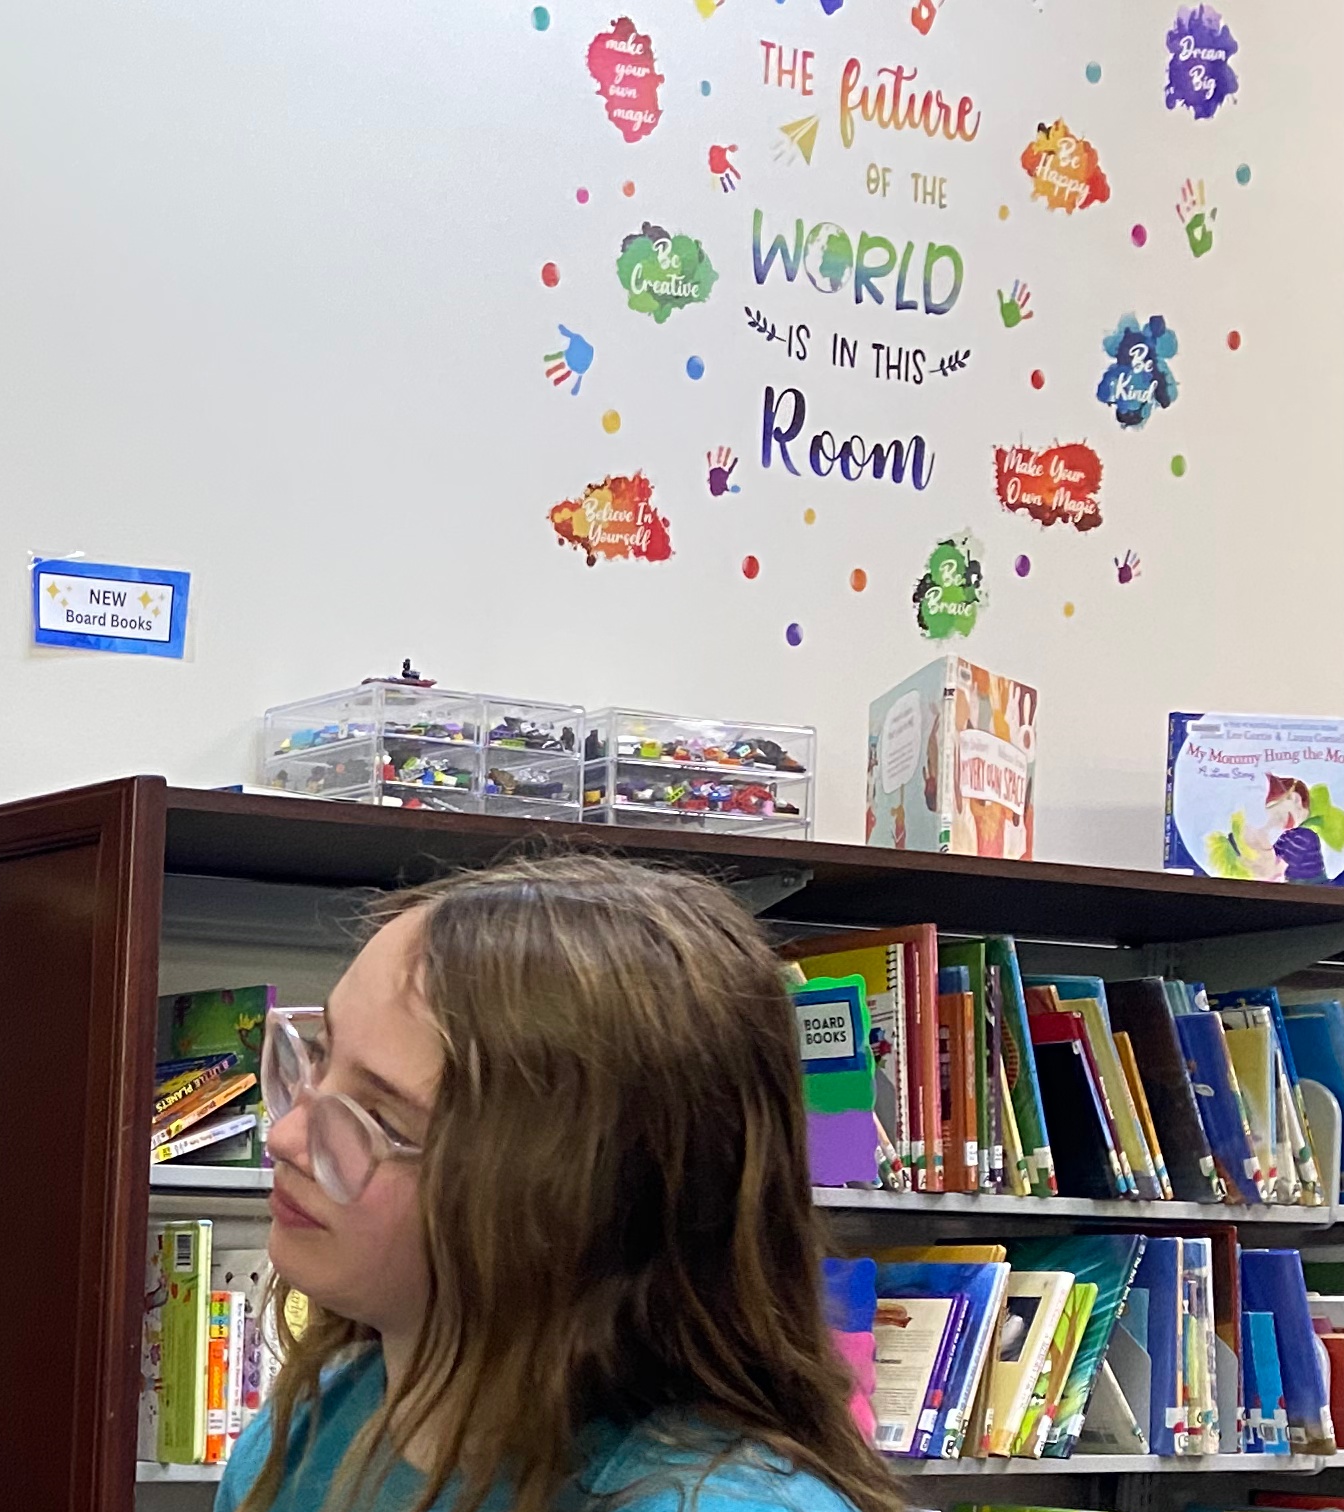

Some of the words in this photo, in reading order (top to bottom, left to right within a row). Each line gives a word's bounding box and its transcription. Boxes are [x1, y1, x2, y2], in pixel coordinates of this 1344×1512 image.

[605, 33, 644, 55] make
[1179, 34, 1226, 61] Dream
[614, 63, 651, 85] your
[1189, 64, 1217, 100] Big
[608, 85, 638, 99] own
[760, 39, 815, 96] THE
[839, 57, 982, 149] future
[613, 108, 656, 132] magic
[1056, 137, 1081, 169] Be
[866, 162, 893, 198] OF
[910, 172, 948, 209] THE
[1034, 152, 1091, 209] Happy
[652, 237, 682, 270] Be
[752, 207, 965, 316] WORLD
[630, 262, 700, 298] Creative
[787, 323, 811, 361] IS
[832, 332, 859, 368] IN
[872, 342, 927, 385] THIS
[1128, 343, 1154, 374] Be
[1115, 371, 1159, 404] Kind
[761, 385, 936, 491] Room
[1003, 449, 1045, 477] Make
[1049, 454, 1086, 484] Your
[582, 497, 633, 522] Believe
[636, 502, 653, 526] In
[1006, 477, 1043, 506] Own
[1051, 486, 1096, 523] Magic
[588, 520, 652, 552] Yourself
[939, 559, 967, 587] Be
[89, 588, 127, 607] NEW
[924, 586, 972, 617] Brave
[66, 609, 107, 627] Board
[111, 613, 153, 632] Books
[1185, 742, 1207, 763] My
[1208, 747, 1262, 767] Mommy
[1264, 749, 1300, 764] Hung
[1302, 746, 1323, 760] the
[803, 1016, 845, 1031] BOARD
[806, 1030, 847, 1045] BOOKS
[155, 1083, 194, 1113] PLANETS
